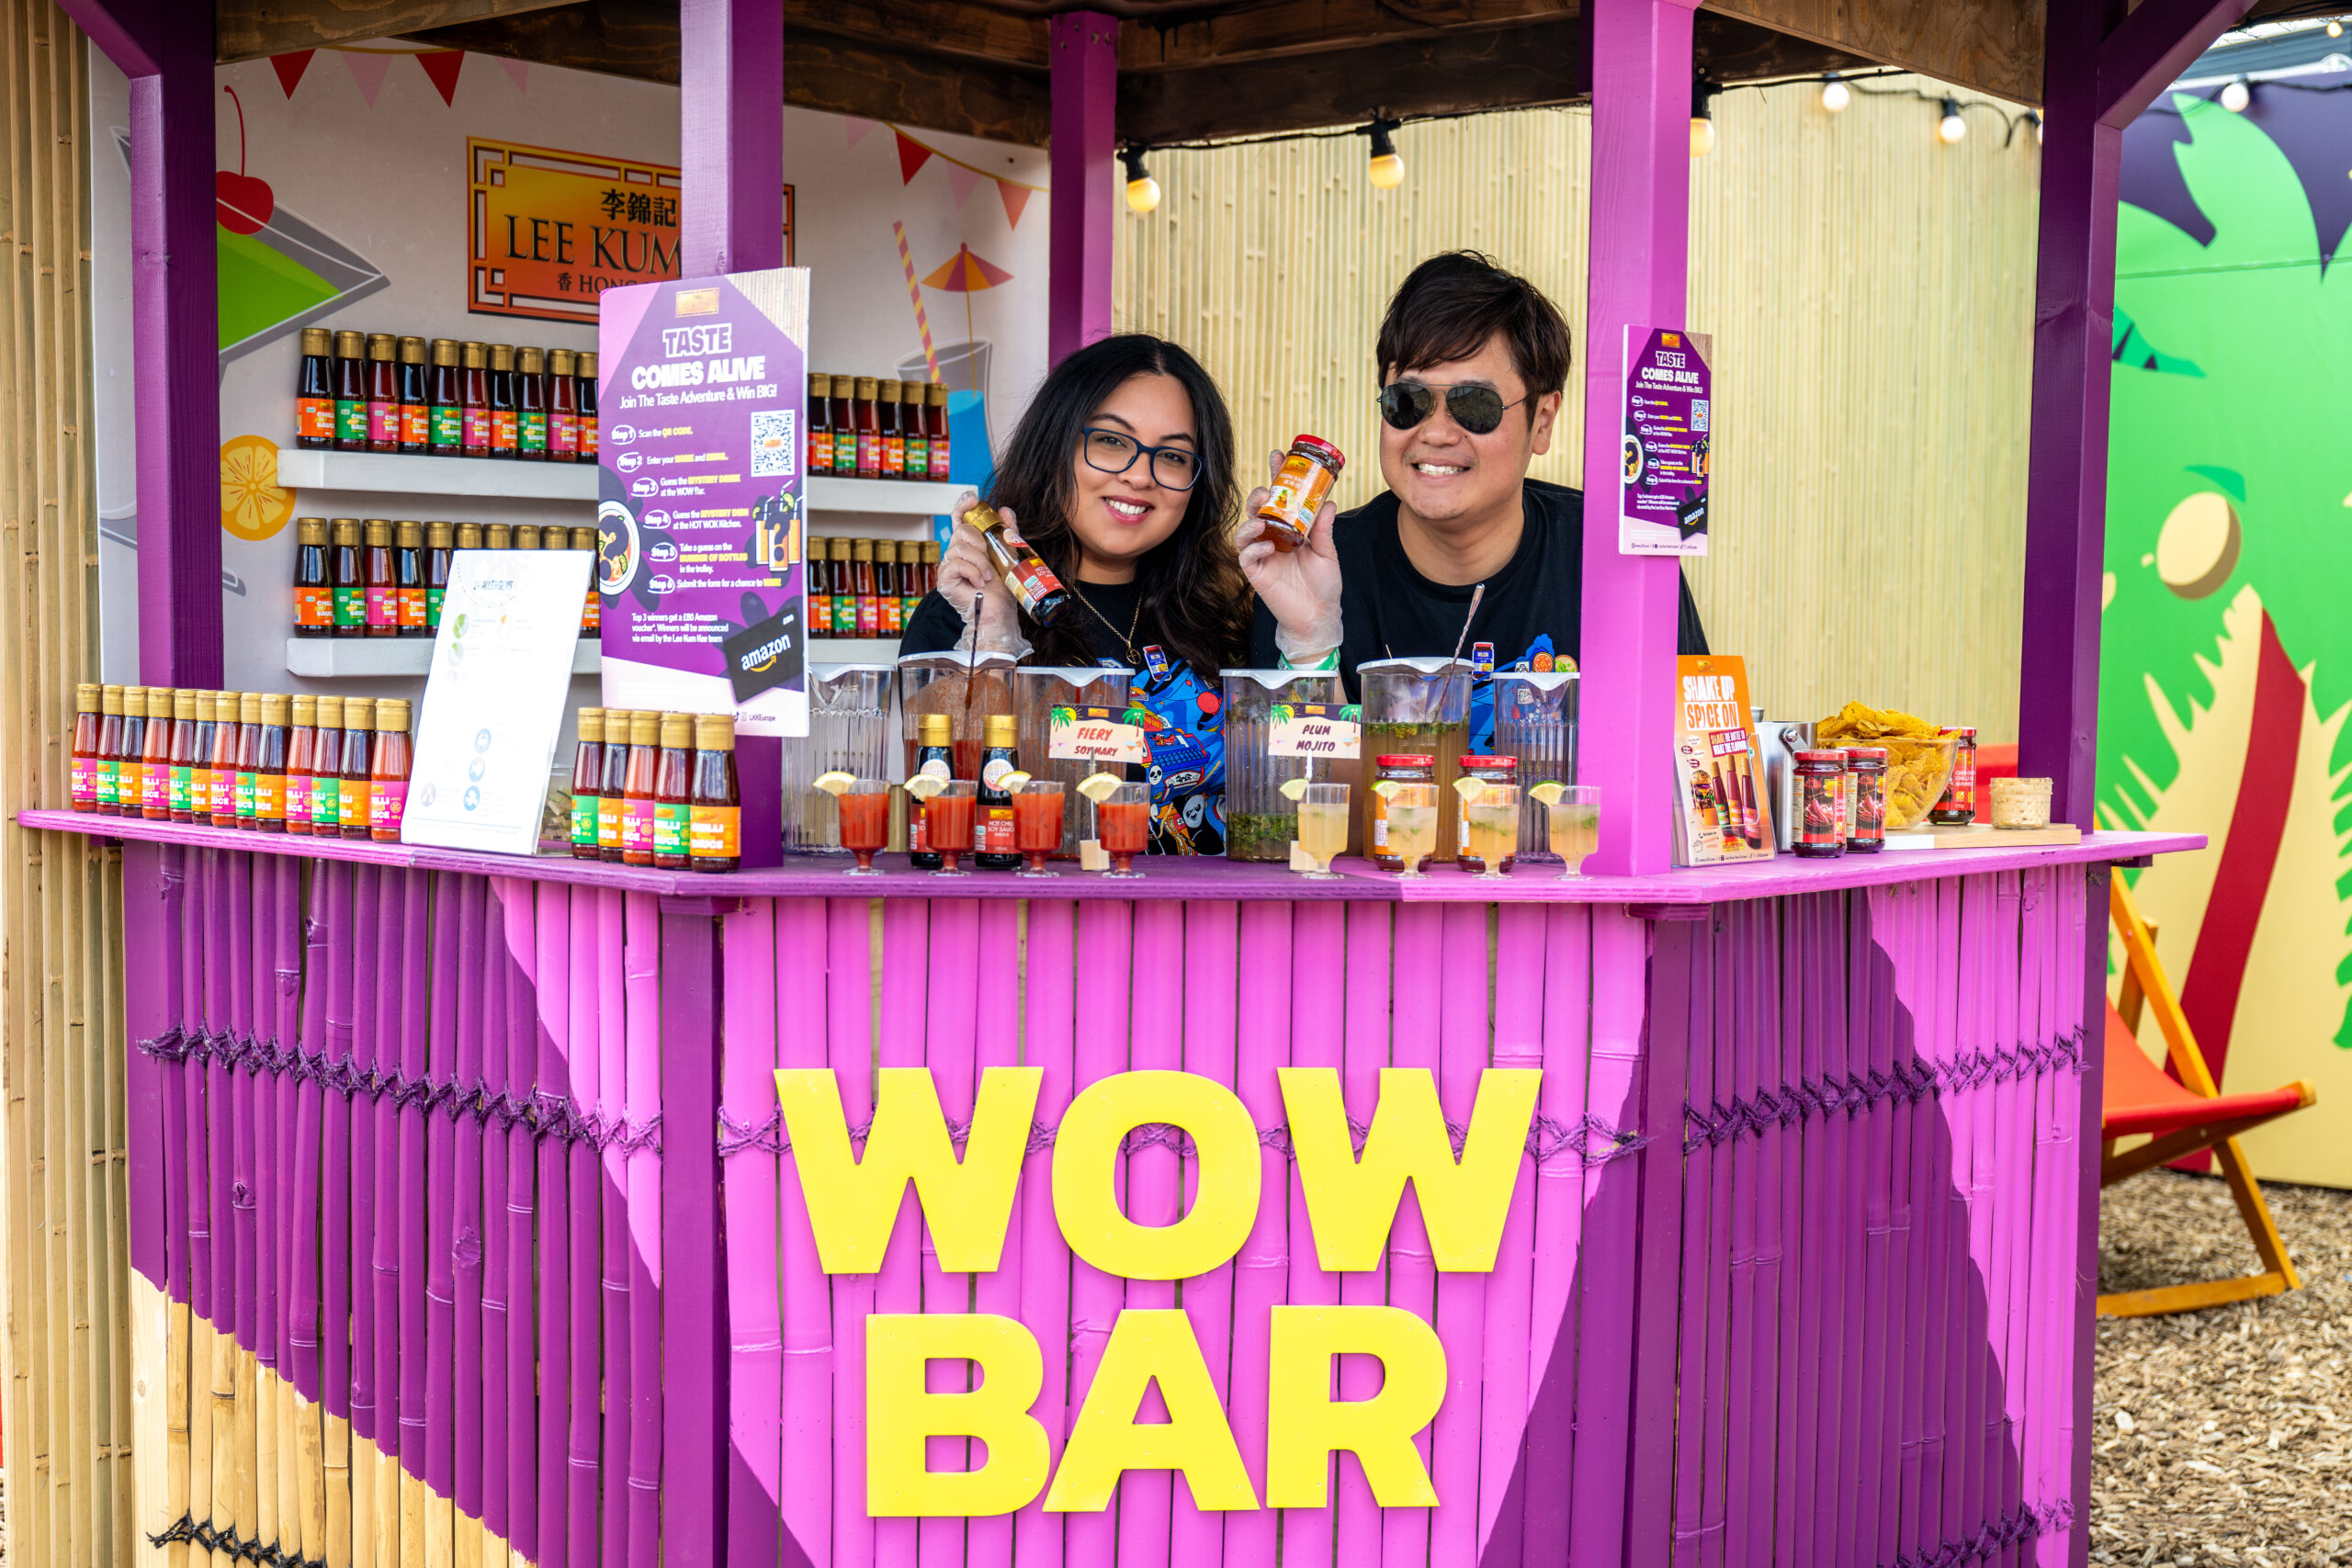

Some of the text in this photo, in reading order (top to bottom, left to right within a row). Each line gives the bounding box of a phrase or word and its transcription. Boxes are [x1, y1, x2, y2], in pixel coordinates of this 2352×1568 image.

[601, 188, 677, 228] 李錦記
[503, 214, 682, 277] LEE KUM
[557, 273, 572, 292] 香
[663, 324, 731, 357] TASTE
[1656, 351, 1685, 368] TASTE
[631, 355, 765, 389] COMES ALIVE
[1641, 367, 1699, 384] COMES ALIVE
[619, 383, 777, 409] Join The Taste Adventure & Win BIG!
[611, 432, 629, 442] Step
[639, 429, 651, 438] Scan
[652, 428, 662, 437] the
[618, 455, 643, 468] Step 2
[647, 456, 662, 465] Enter
[662, 456, 674, 466] your
[695, 453, 706, 462] and
[661, 478, 677, 487] Guess
[678, 477, 687, 485] the
[632, 483, 650, 494] Step
[661, 489, 666, 497] at
[666, 488, 676, 496] the
[676, 487, 694, 496] WOW
[645, 514, 662, 526] Step
[673, 511, 690, 519] Guess
[690, 510, 700, 518] the
[1684, 507, 1704, 525] amazon
[673, 522, 679, 530] at
[679, 521, 689, 530] the
[689, 520, 703, 529] HOT
[703, 520, 718, 529] WOK
[651, 547, 669, 558] Step
[679, 544, 693, 552] Take
[697, 544, 714, 553] guess
[722, 542, 732, 551] the
[679, 565, 685, 573] in
[685, 565, 695, 573] the
[649, 580, 666, 591] Step
[677, 580, 697, 588] Submit
[698, 580, 707, 588] the
[707, 580, 721, 588] form
[721, 580, 730, 588] for
[736, 579, 755, 587] chance
[756, 579, 763, 587] to
[632, 614, 642, 622] Top
[648, 614, 668, 622] winners
[695, 613, 718, 622] Amazon
[657, 624, 680, 632] Winners
[680, 624, 689, 632] will
[689, 624, 697, 632] be
[698, 623, 729, 632] announced
[640, 635, 655, 643] email
[656, 635, 662, 644] by
[662, 635, 672, 643] the
[673, 635, 683, 643] Lee
[708, 635, 723, 643] team
[741, 634, 791, 671] amazon
[1683, 675, 1735, 702] SHAKE UP
[1687, 703, 1738, 729] SPICE ON
[1077, 727, 1114, 741] FIERY
[1302, 724, 1331, 736] PLUM
[1074, 745, 1118, 757] SOY MARY
[1296, 740, 1336, 752] MOJITO
[774, 1066, 1544, 1280] WOW
[865, 1304, 1448, 1517] BAR
